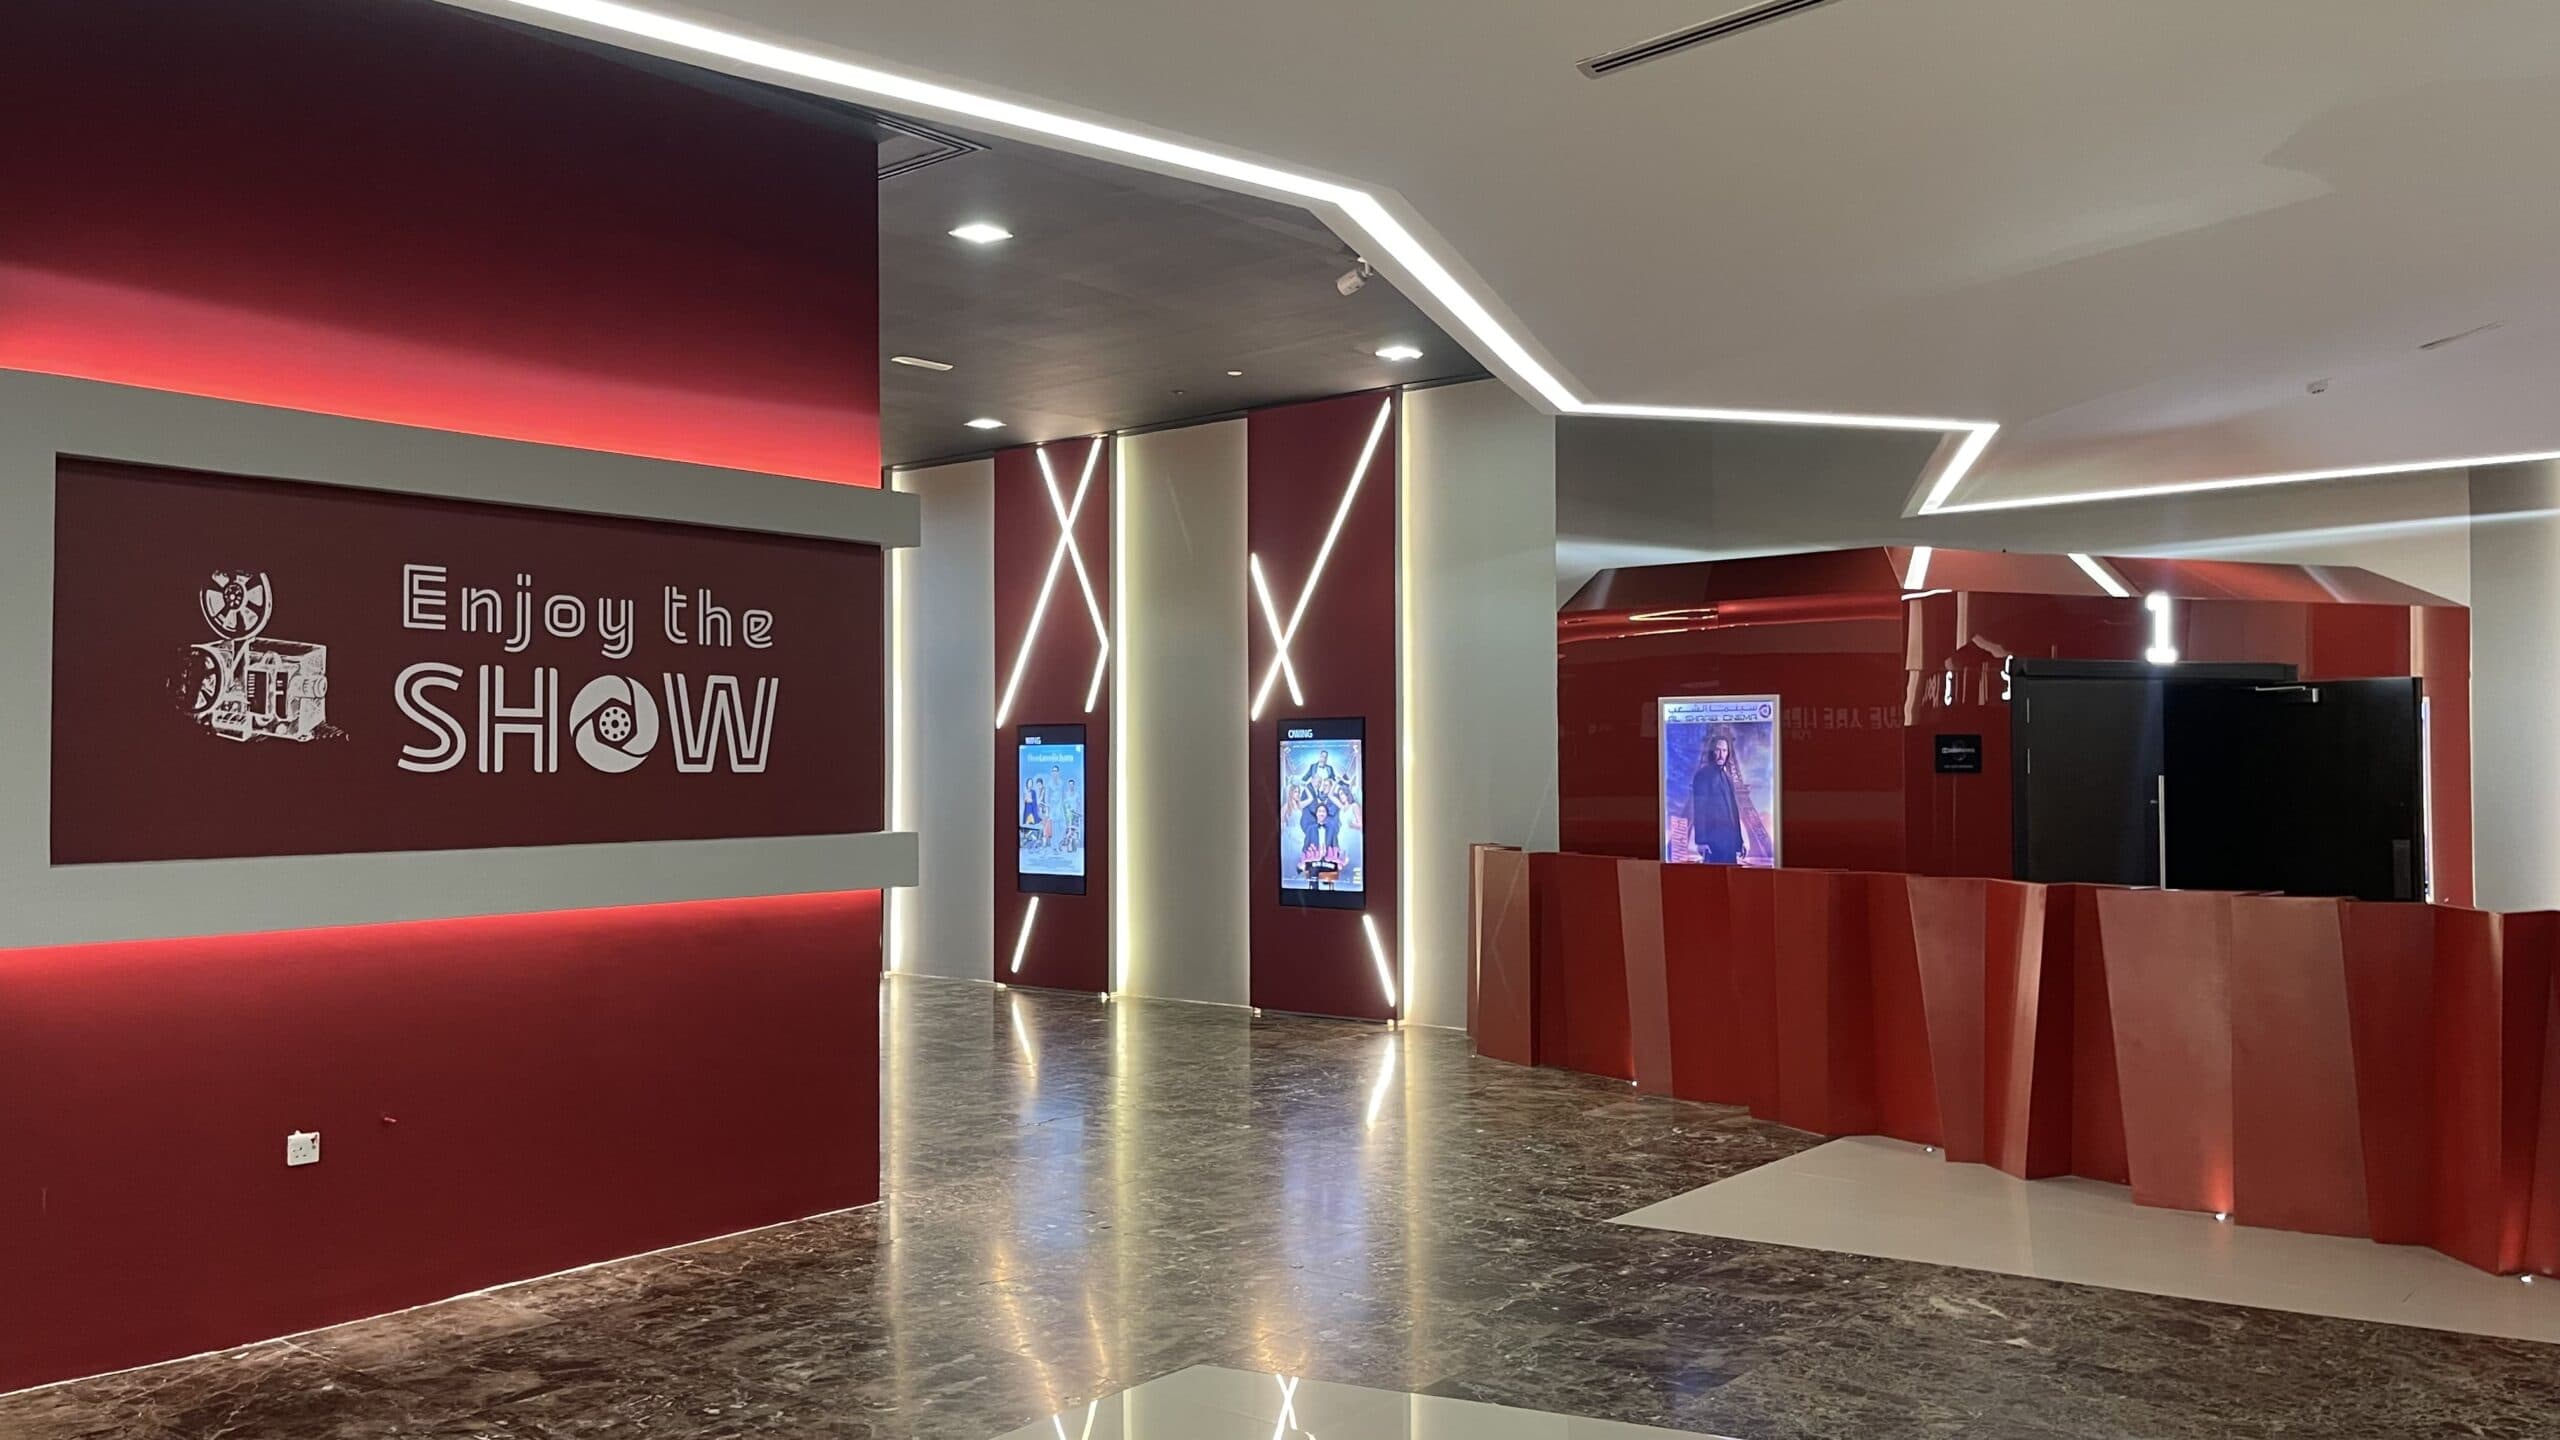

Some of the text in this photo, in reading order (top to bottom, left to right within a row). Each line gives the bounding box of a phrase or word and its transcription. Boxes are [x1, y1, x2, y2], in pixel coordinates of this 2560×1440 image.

[403, 563, 774, 659] Enjoy the
[2146, 592, 2177, 664] 1
[394, 662, 779, 774] SHOW
